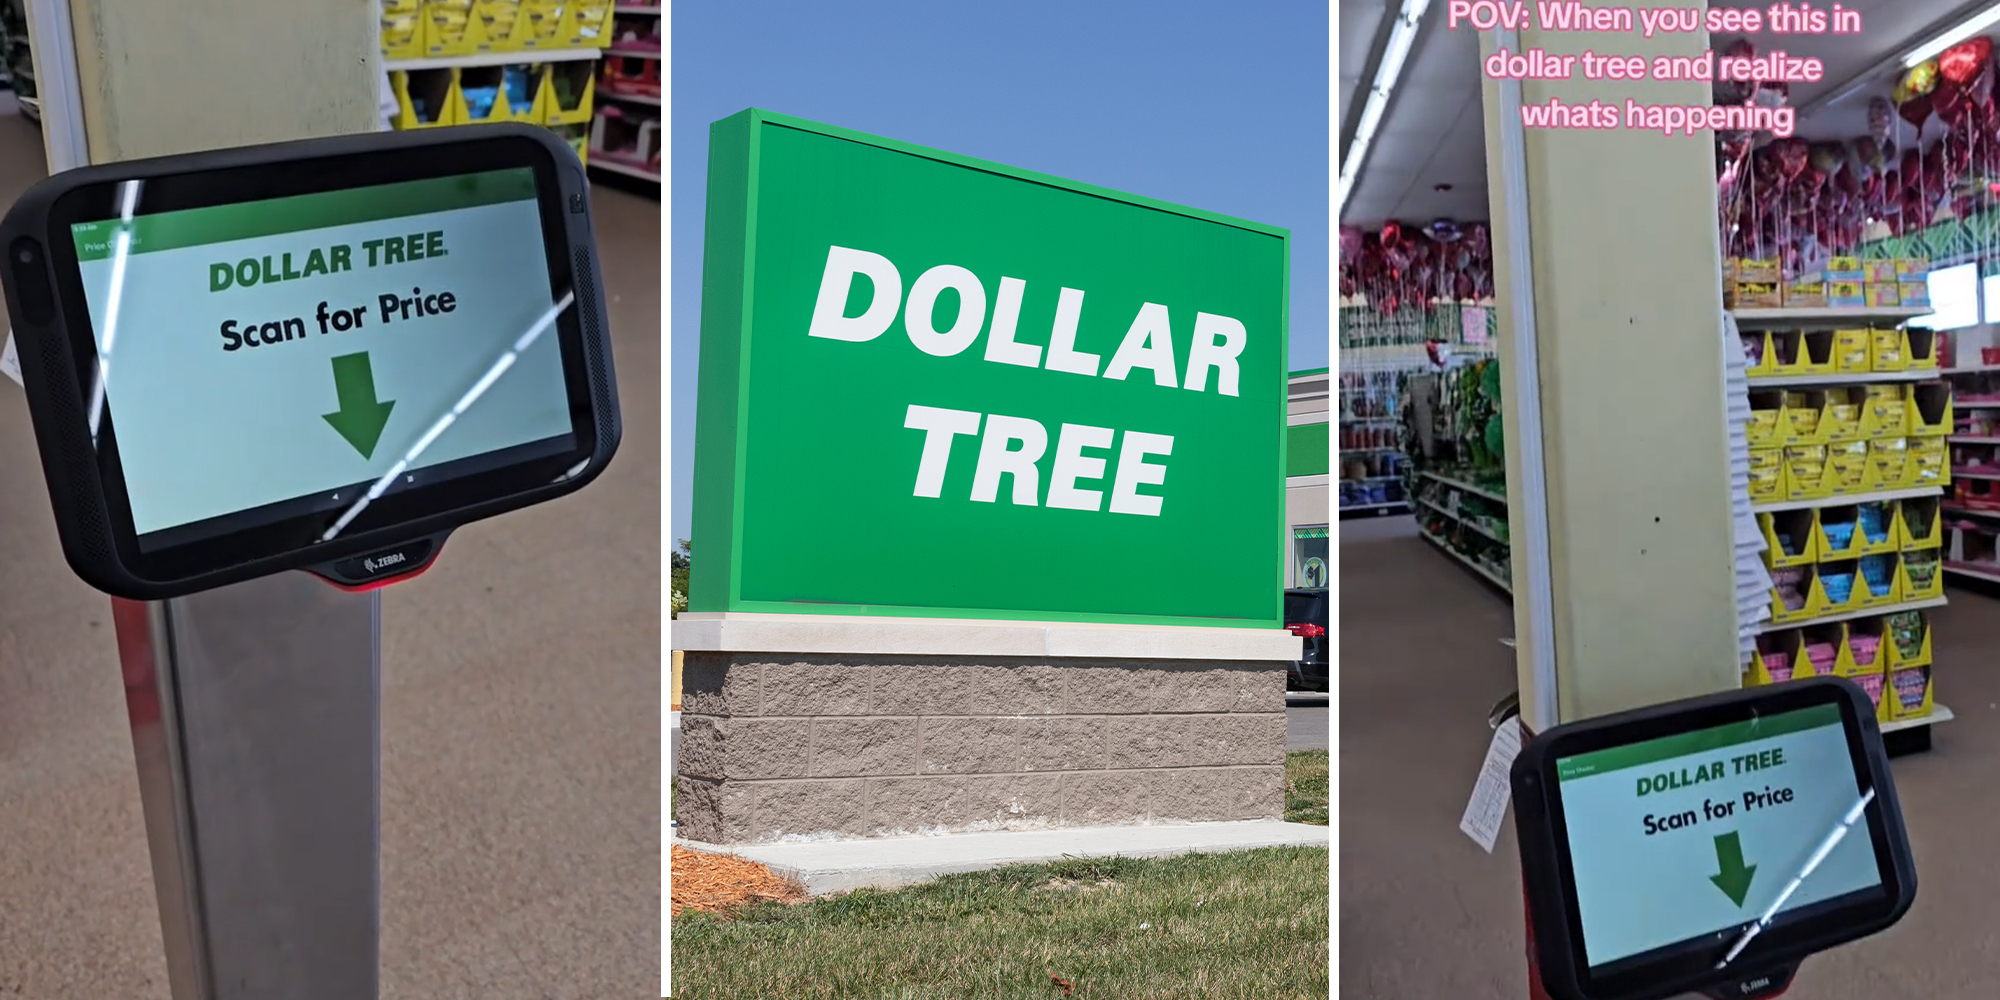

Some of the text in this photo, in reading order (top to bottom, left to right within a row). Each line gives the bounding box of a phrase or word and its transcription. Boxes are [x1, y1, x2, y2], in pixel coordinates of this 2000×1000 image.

[209, 244, 352, 293] DOLLAR
[220, 286, 457, 352] Scan for Price
[807, 244, 1248, 398] DOLLAR
[903, 404, 1175, 517] TREE
[377, 552, 406, 568] ZEBRA
[1636, 760, 1726, 798] DOLLAR
[1642, 785, 1795, 836] Scan for Price
